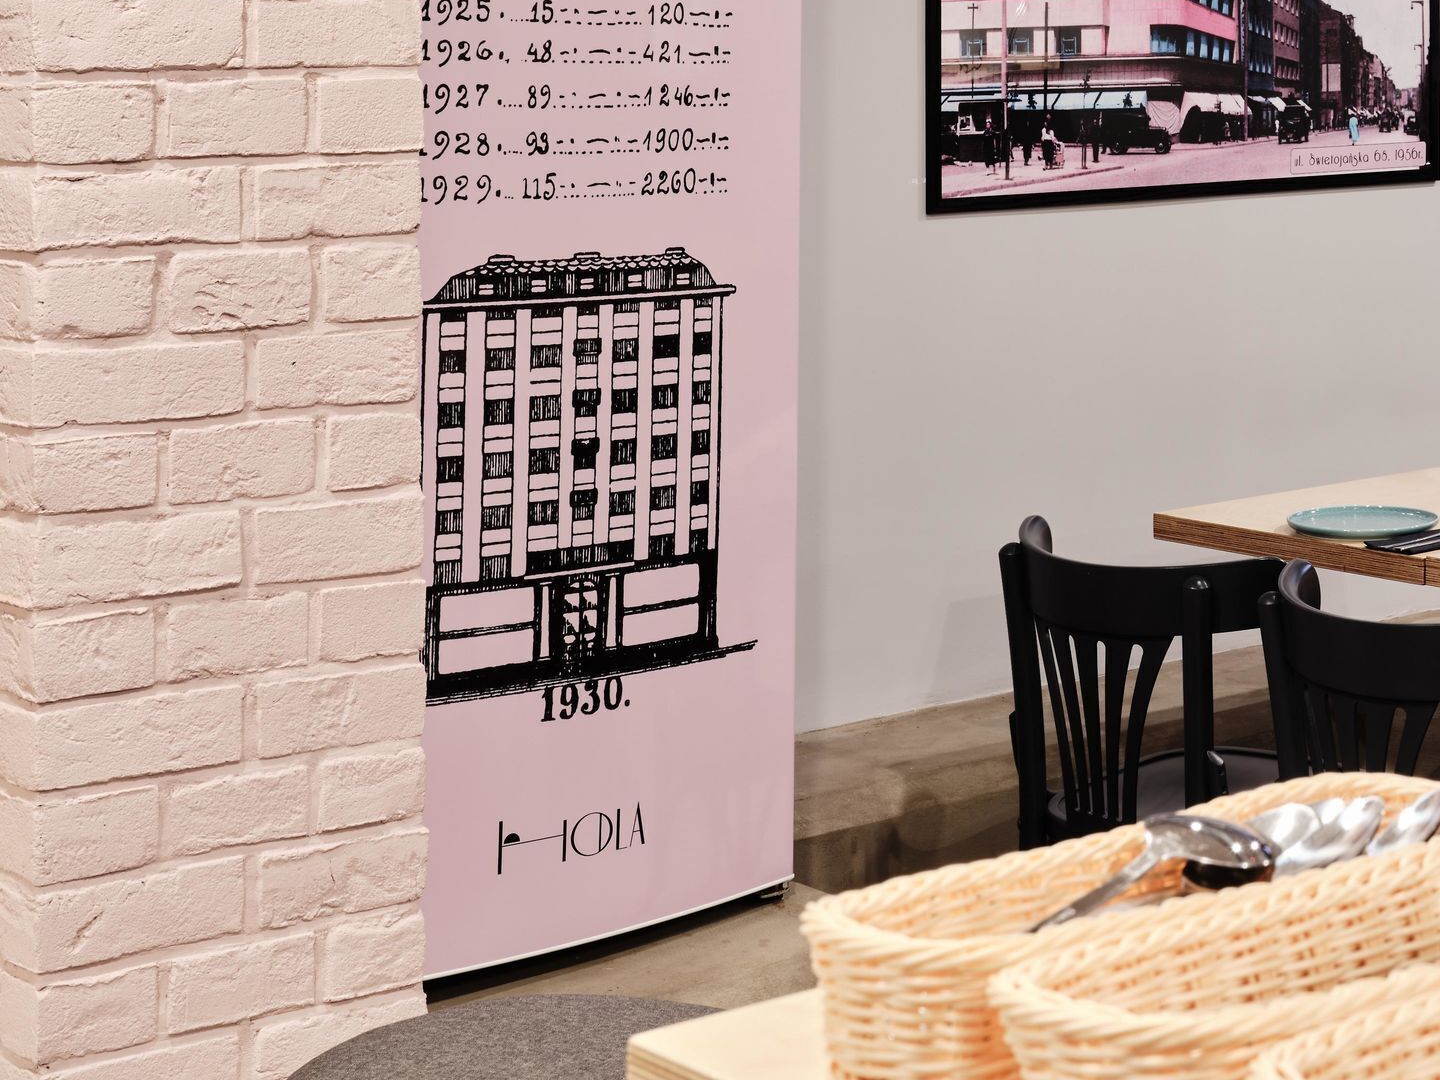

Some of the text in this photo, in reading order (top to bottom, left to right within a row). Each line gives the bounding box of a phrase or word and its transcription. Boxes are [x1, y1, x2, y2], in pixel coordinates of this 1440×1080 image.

[529, 0, 554, 24] 15
[648, 2, 685, 26] 120
[420, 39, 681, 68] 1926 48 421
[422, 83, 489, 115] 1927
[527, 84, 551, 110] 89
[419, 130, 490, 161] 928
[642, 127, 694, 154] 1900
[522, 172, 557, 201] 115
[640, 167, 696, 196] 2260
[541, 676, 631, 723] 1930.
